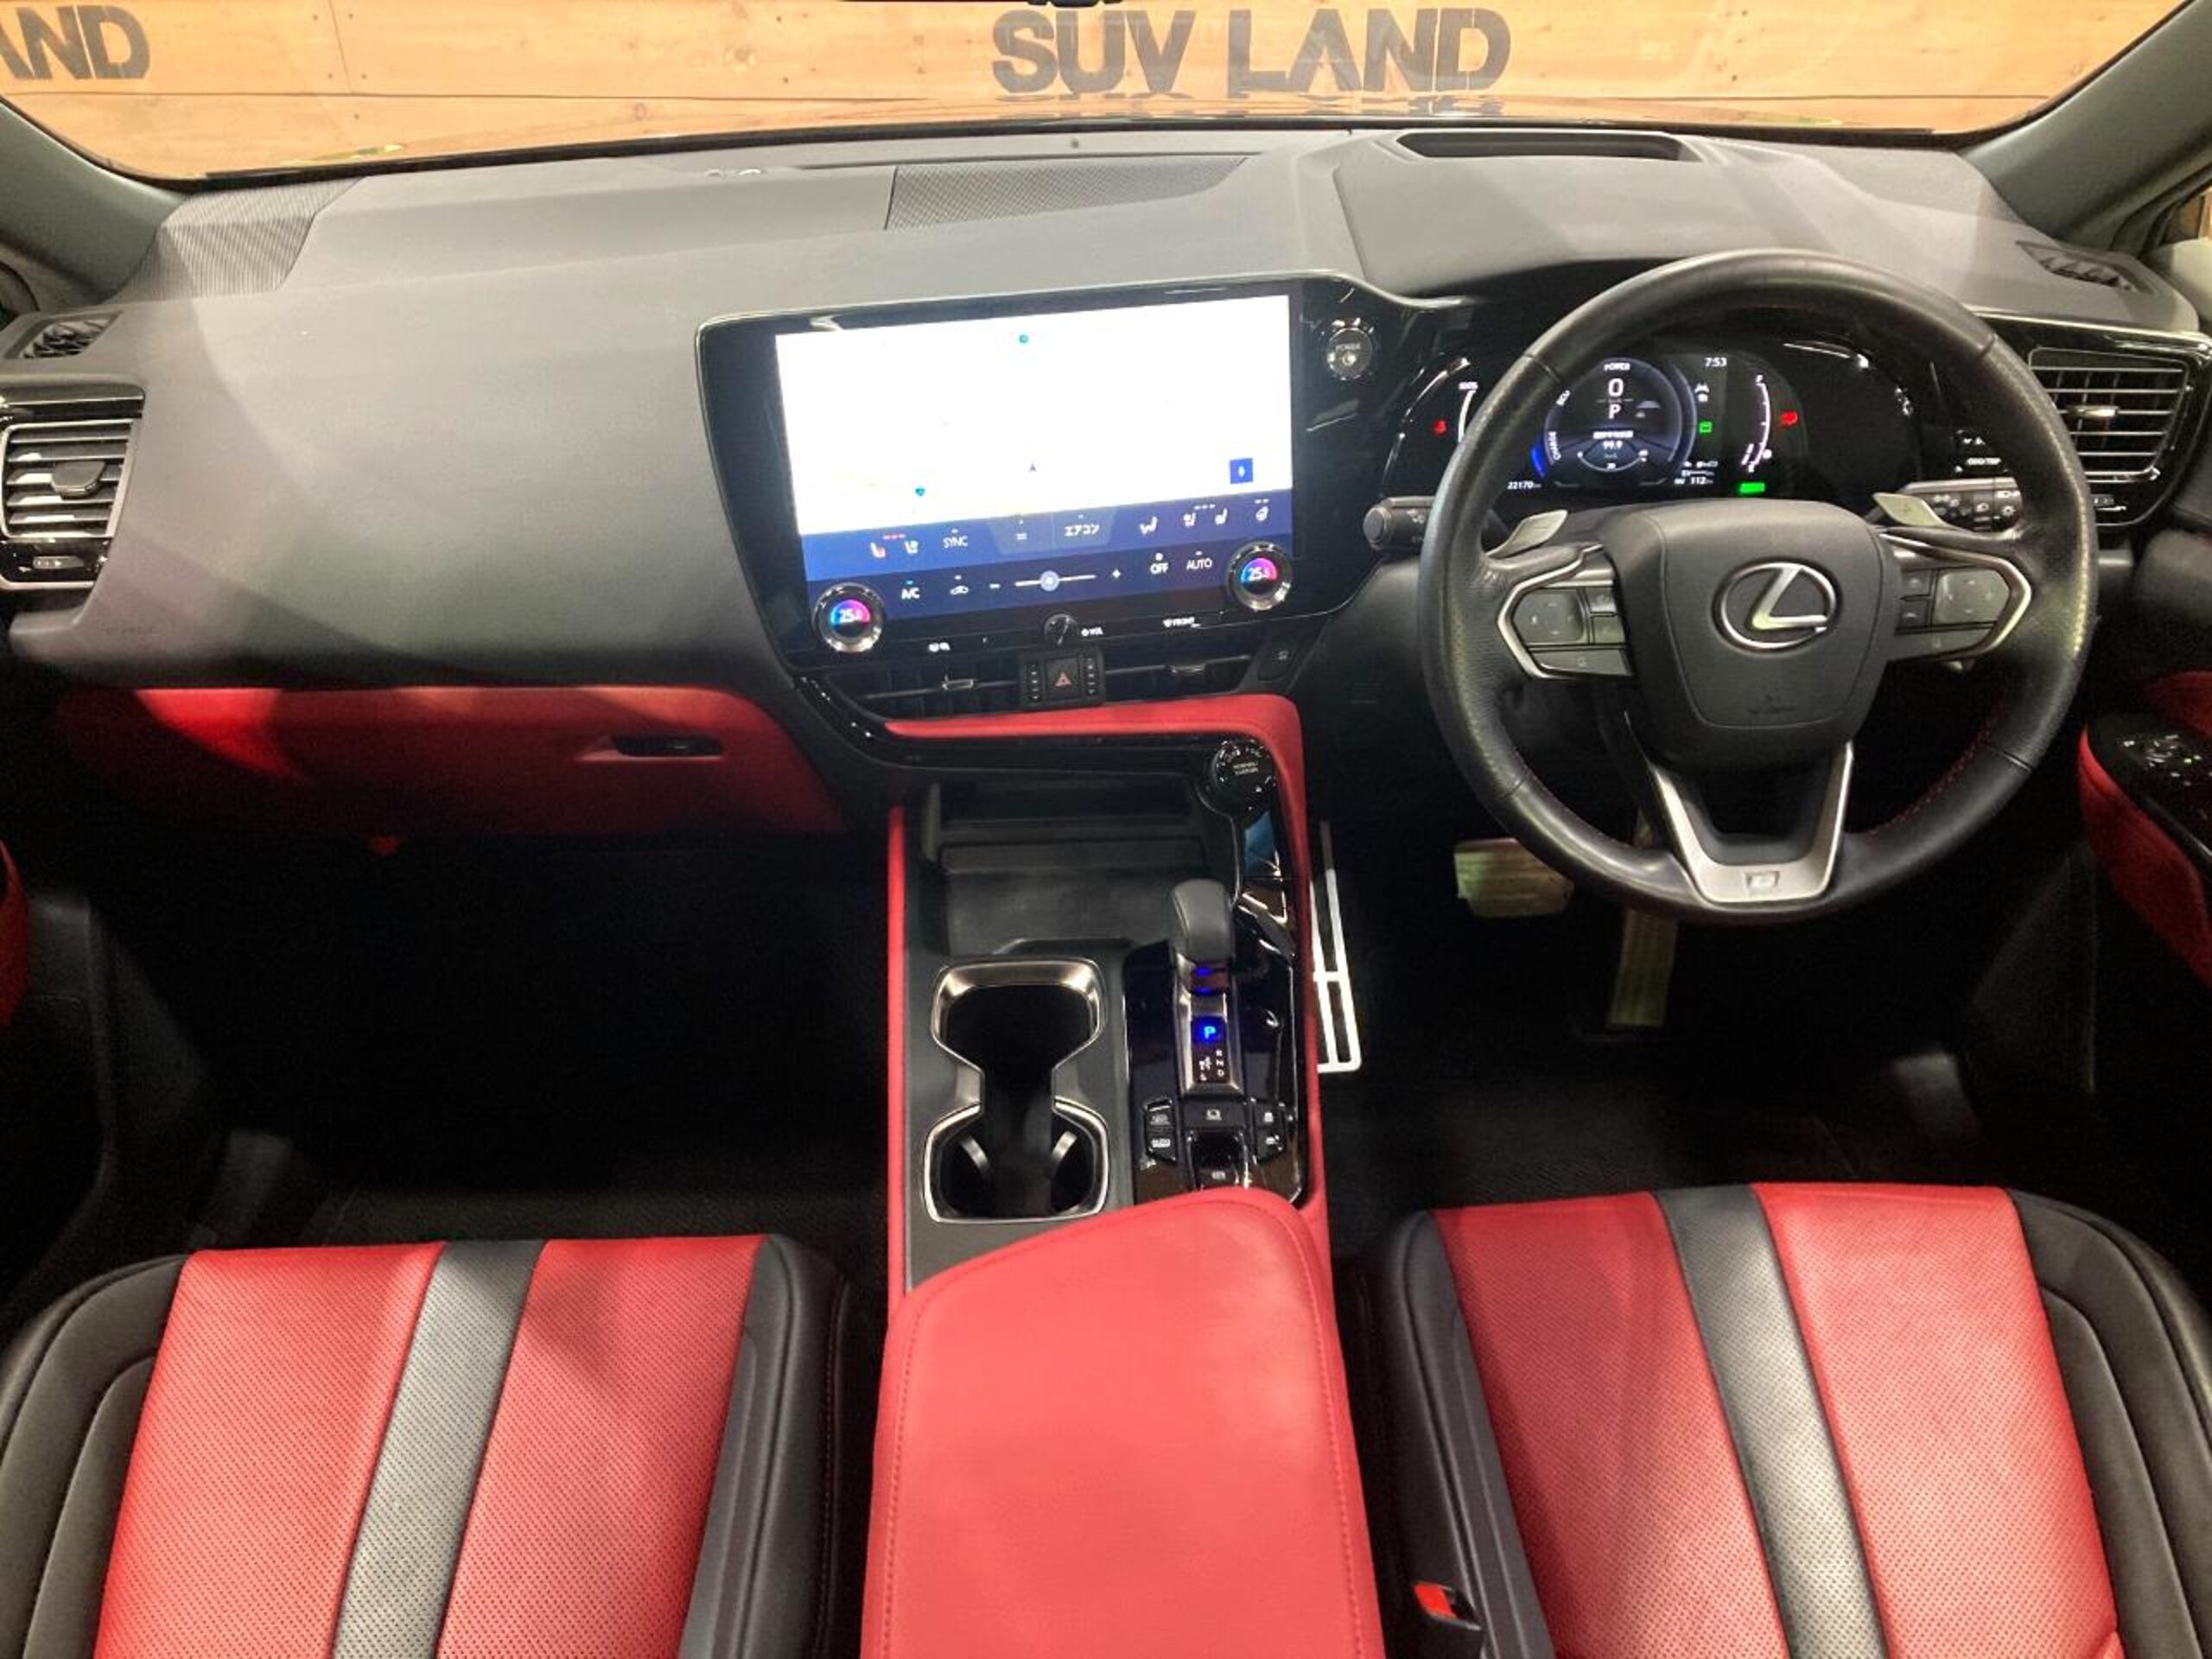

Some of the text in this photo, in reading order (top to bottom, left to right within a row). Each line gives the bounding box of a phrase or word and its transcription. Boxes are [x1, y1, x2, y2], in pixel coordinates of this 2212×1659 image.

[992, 8, 1512, 94] SUV LAND
[1705, 357, 1727, 368] 7:53
[1608, 404, 1622, 420] P
[1064, 524, 1100, 537] エアコン
[942, 535, 969, 549] SYNC
[1150, 563, 1169, 575] OFF
[1186, 557, 1212, 570] AUTO
[1204, 1026, 1217, 1039] P
